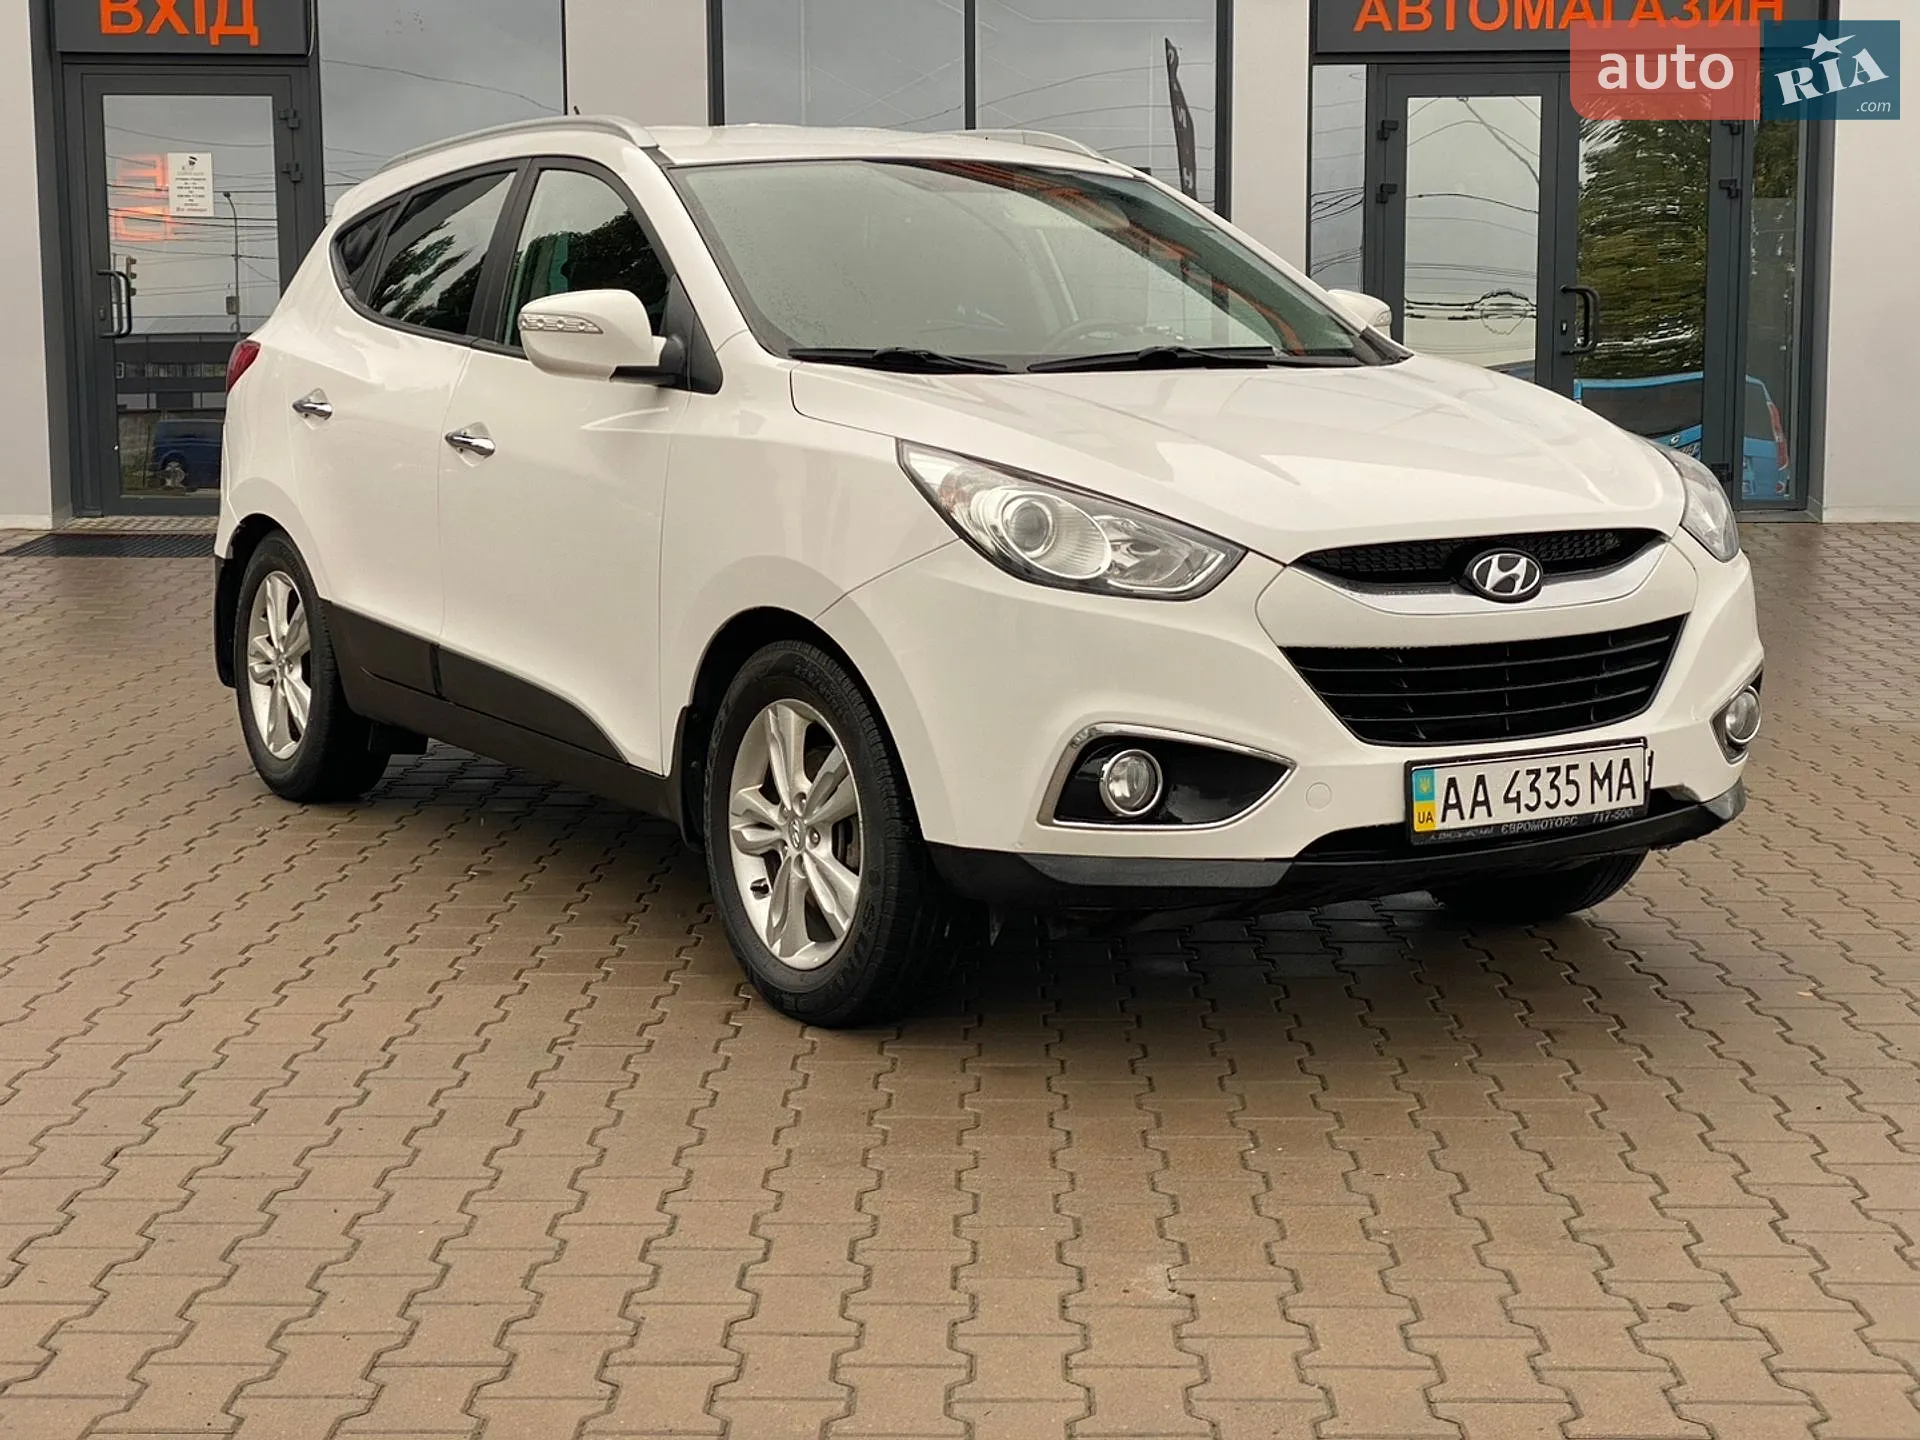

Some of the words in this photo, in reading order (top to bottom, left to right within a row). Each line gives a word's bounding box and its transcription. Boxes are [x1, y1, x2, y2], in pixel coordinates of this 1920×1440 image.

[101, 0, 259, 46] ВХІД
[1353, 0, 1784, 31] АВТОМАГАЗИН
[1503, 763, 1580, 814] 4335
[1418, 811, 1434, 824] UA
